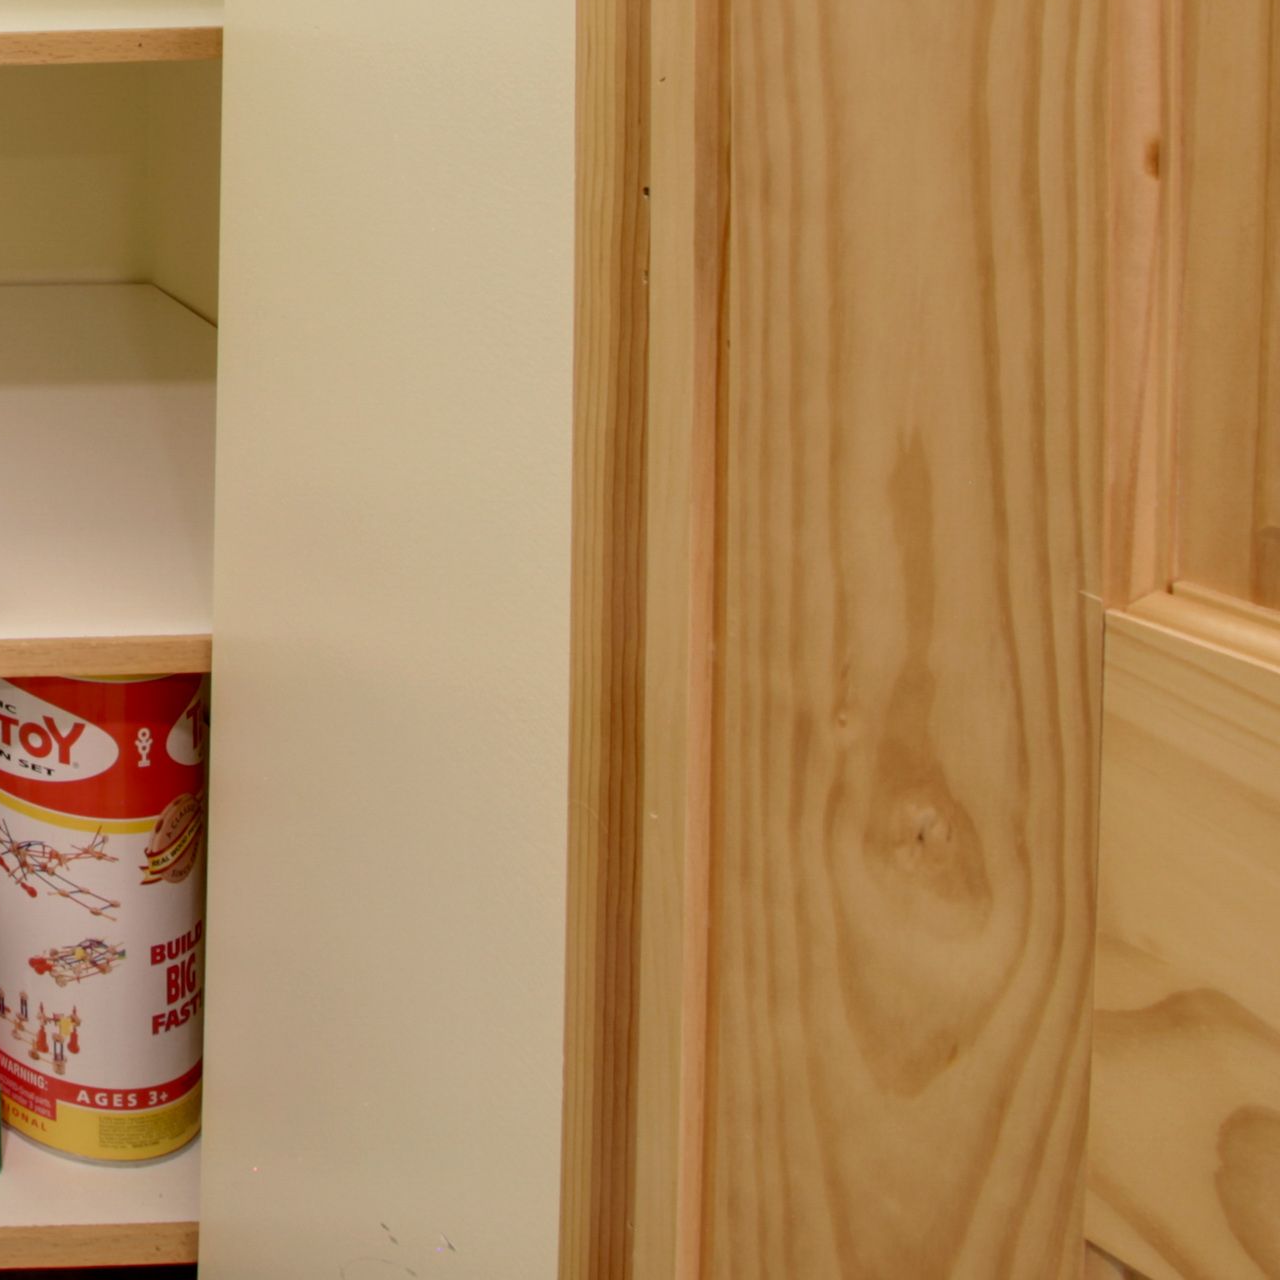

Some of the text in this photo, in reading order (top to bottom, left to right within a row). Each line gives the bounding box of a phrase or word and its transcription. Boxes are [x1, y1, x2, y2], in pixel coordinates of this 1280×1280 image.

[150, 919, 203, 966] BUILD
[166, 952, 196, 1006] BIG
[0, 1052, 49, 1092] WARNING:
[76, 1089, 169, 1107] AGES 3+
